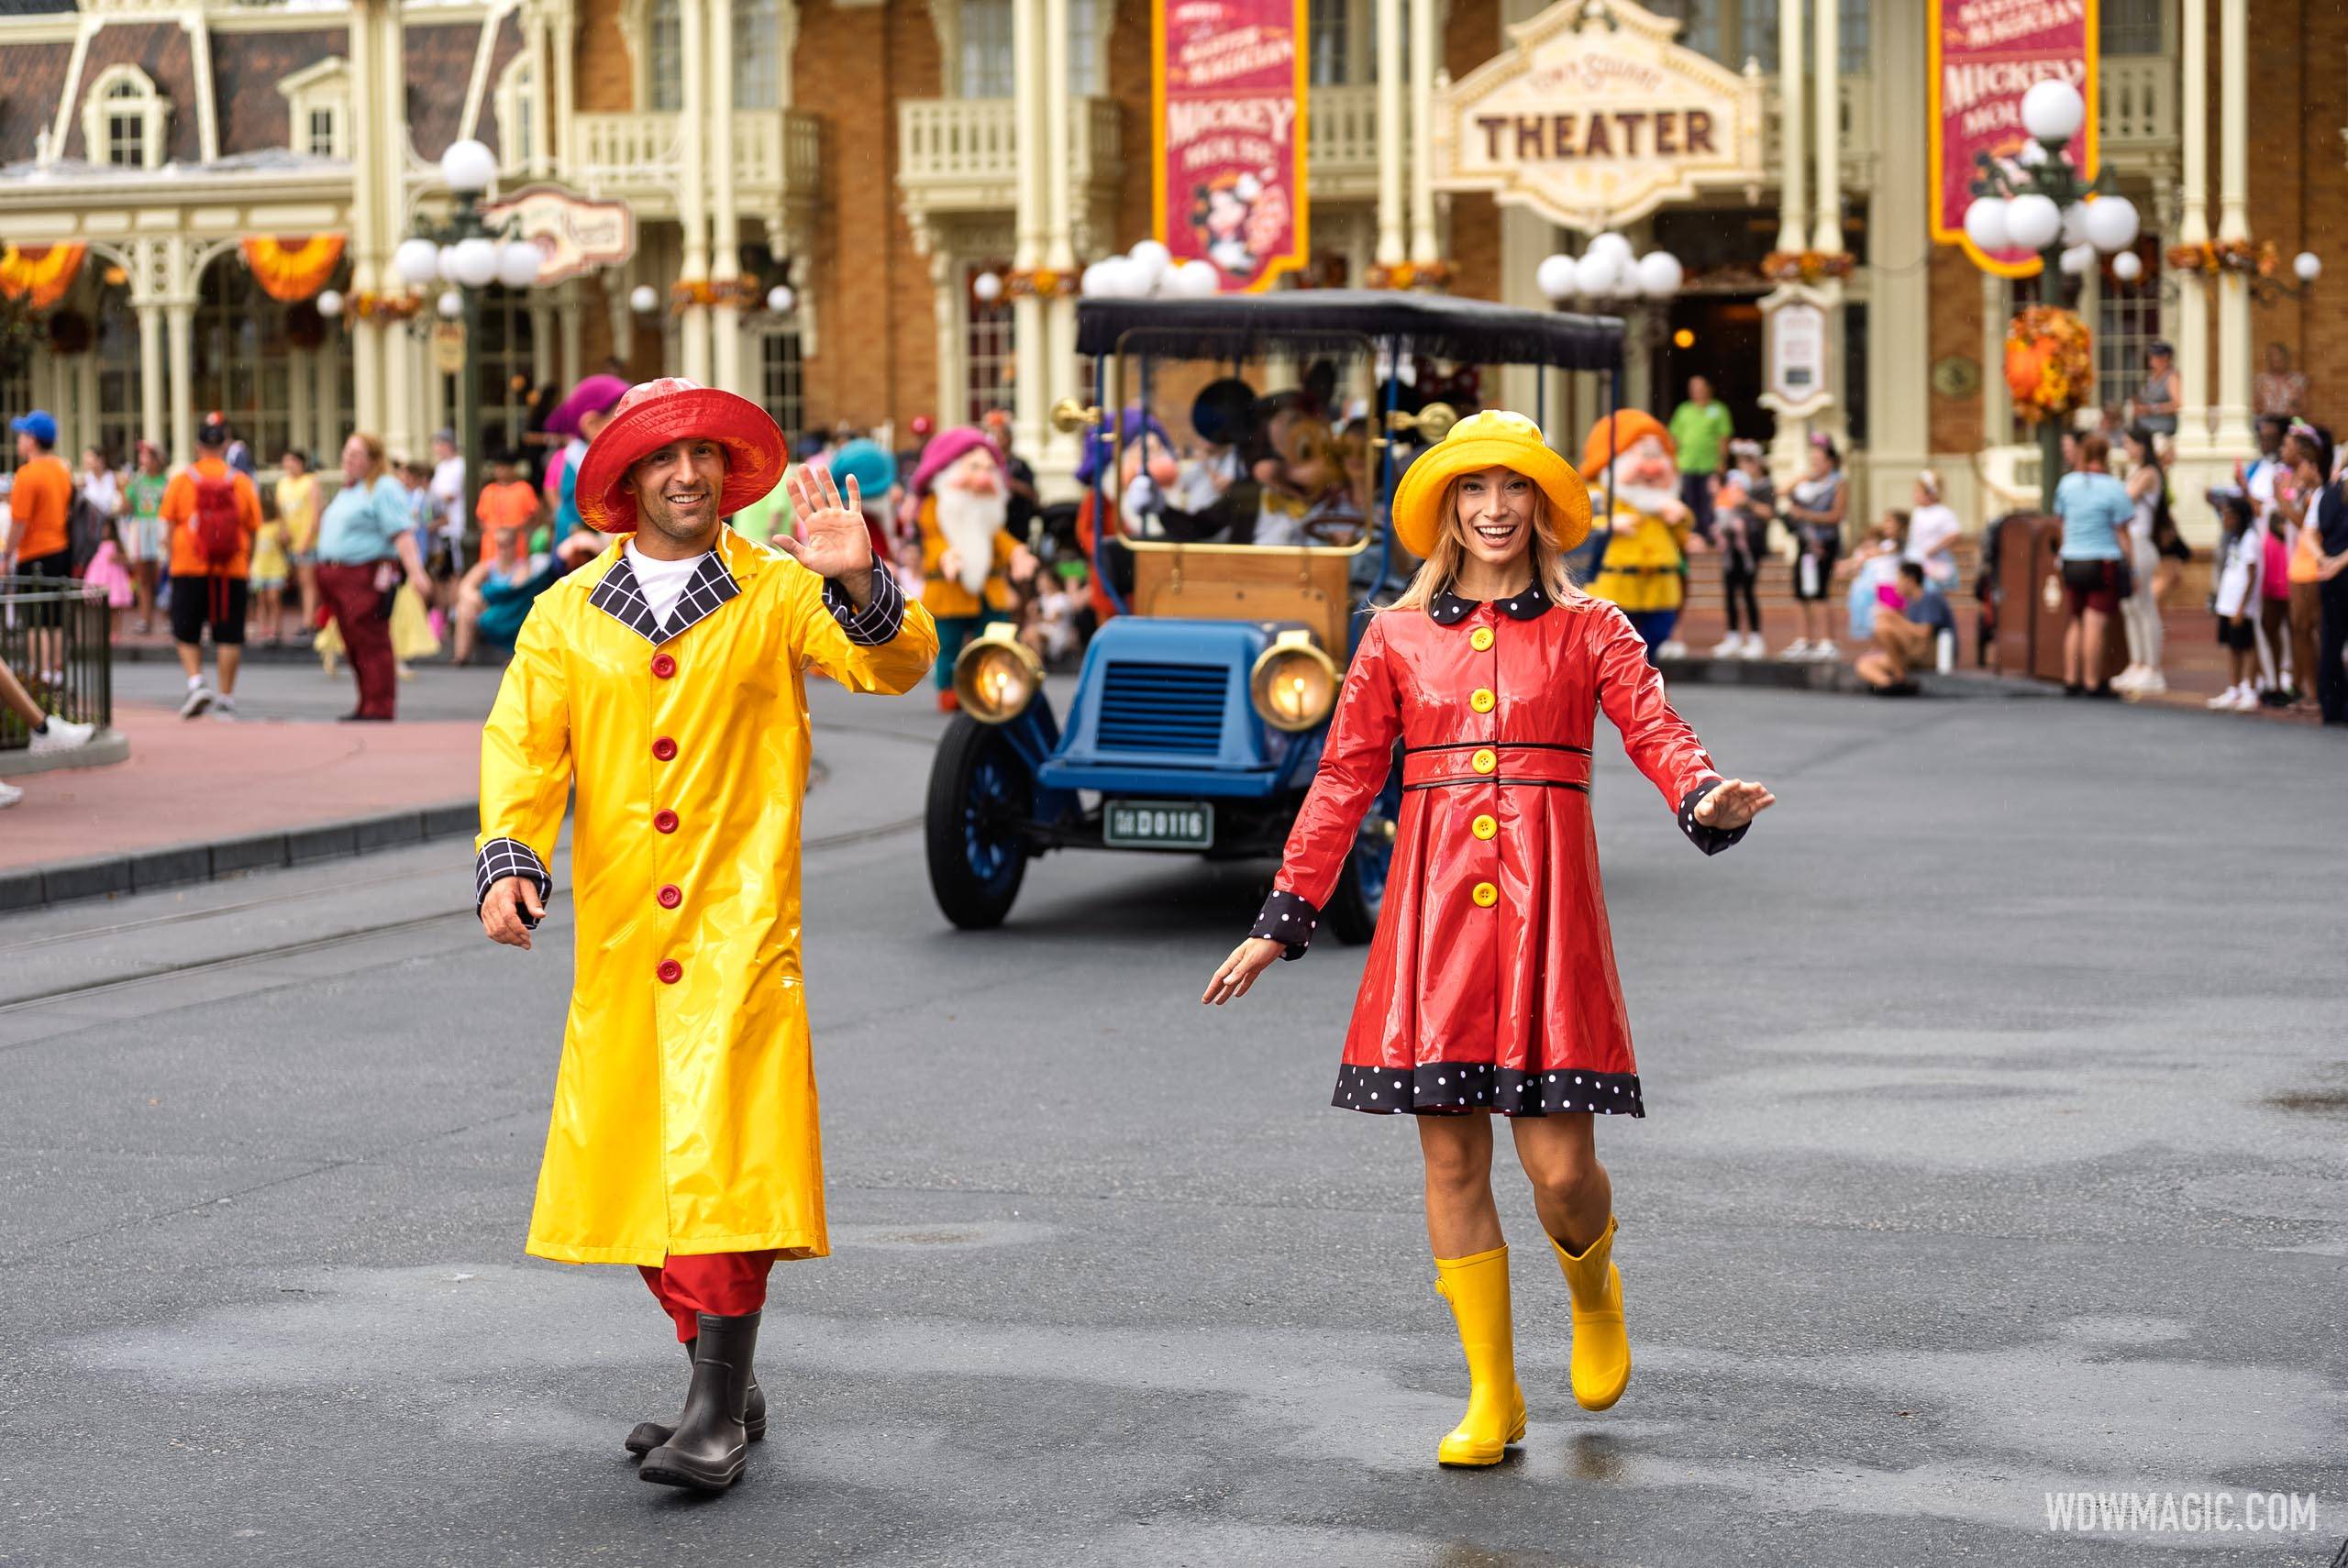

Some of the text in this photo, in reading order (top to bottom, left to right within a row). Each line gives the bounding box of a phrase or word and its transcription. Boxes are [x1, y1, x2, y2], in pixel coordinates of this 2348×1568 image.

[1167, 98, 1297, 148] MICKEY
[1477, 109, 1718, 161] THEATER
[1183, 136, 1276, 169] MOUSE
